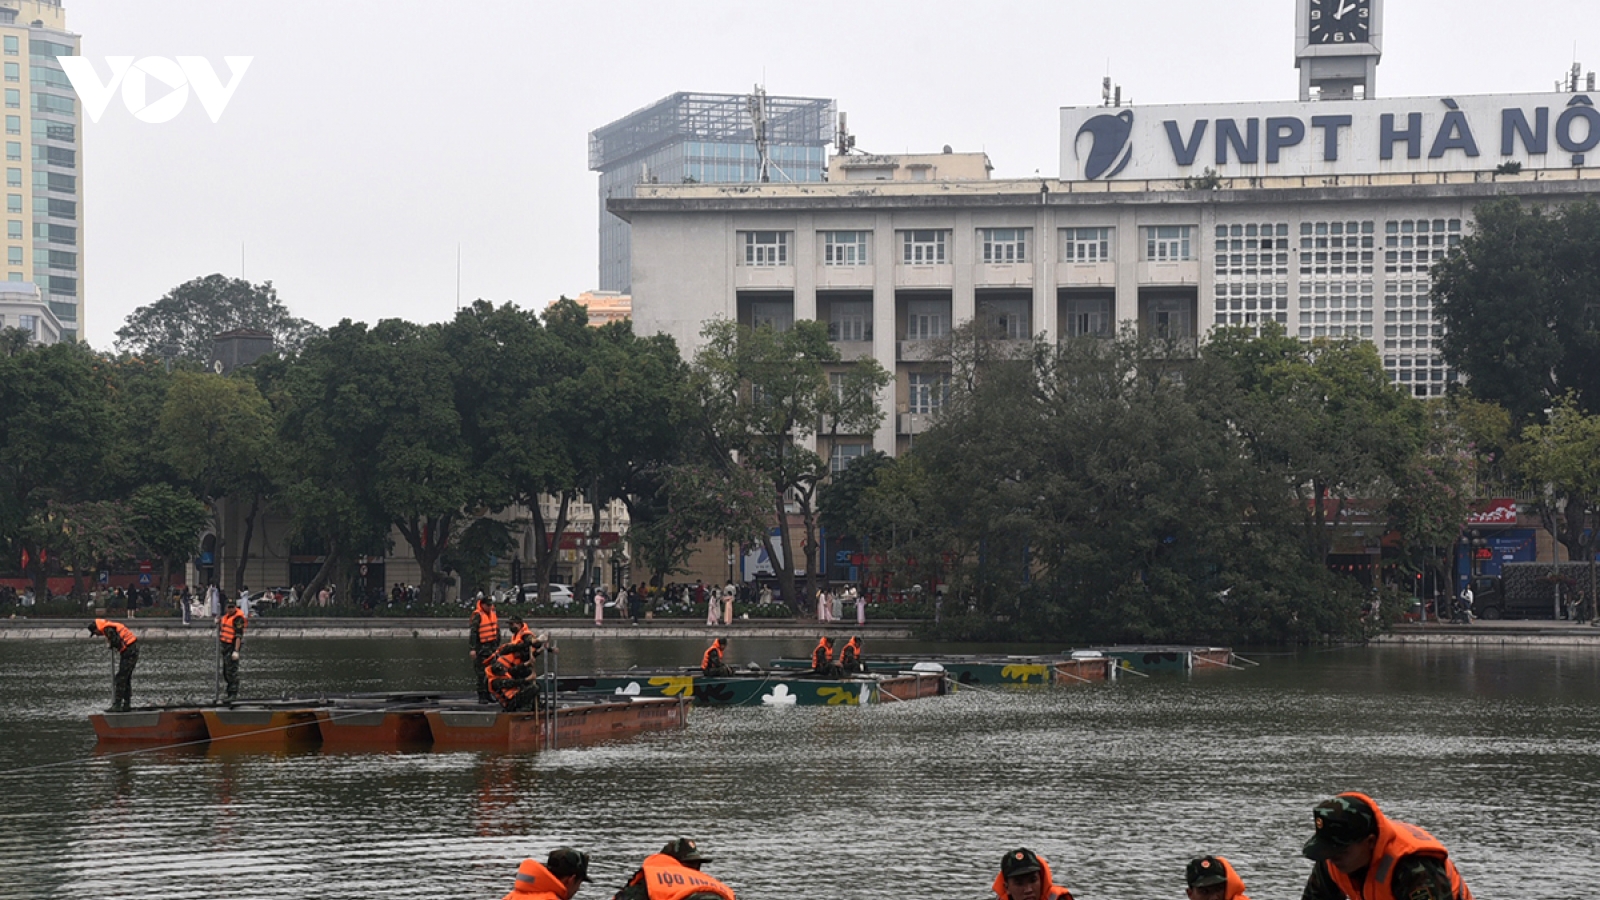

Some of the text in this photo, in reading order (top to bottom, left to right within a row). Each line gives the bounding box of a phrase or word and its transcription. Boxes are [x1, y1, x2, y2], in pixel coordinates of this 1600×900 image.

[1311, 9, 1321, 20] 9
[1358, 7, 1368, 18] 3
[1333, 32, 1344, 42] 6
[1163, 95, 1600, 166] VNPT HÀ NỘ
